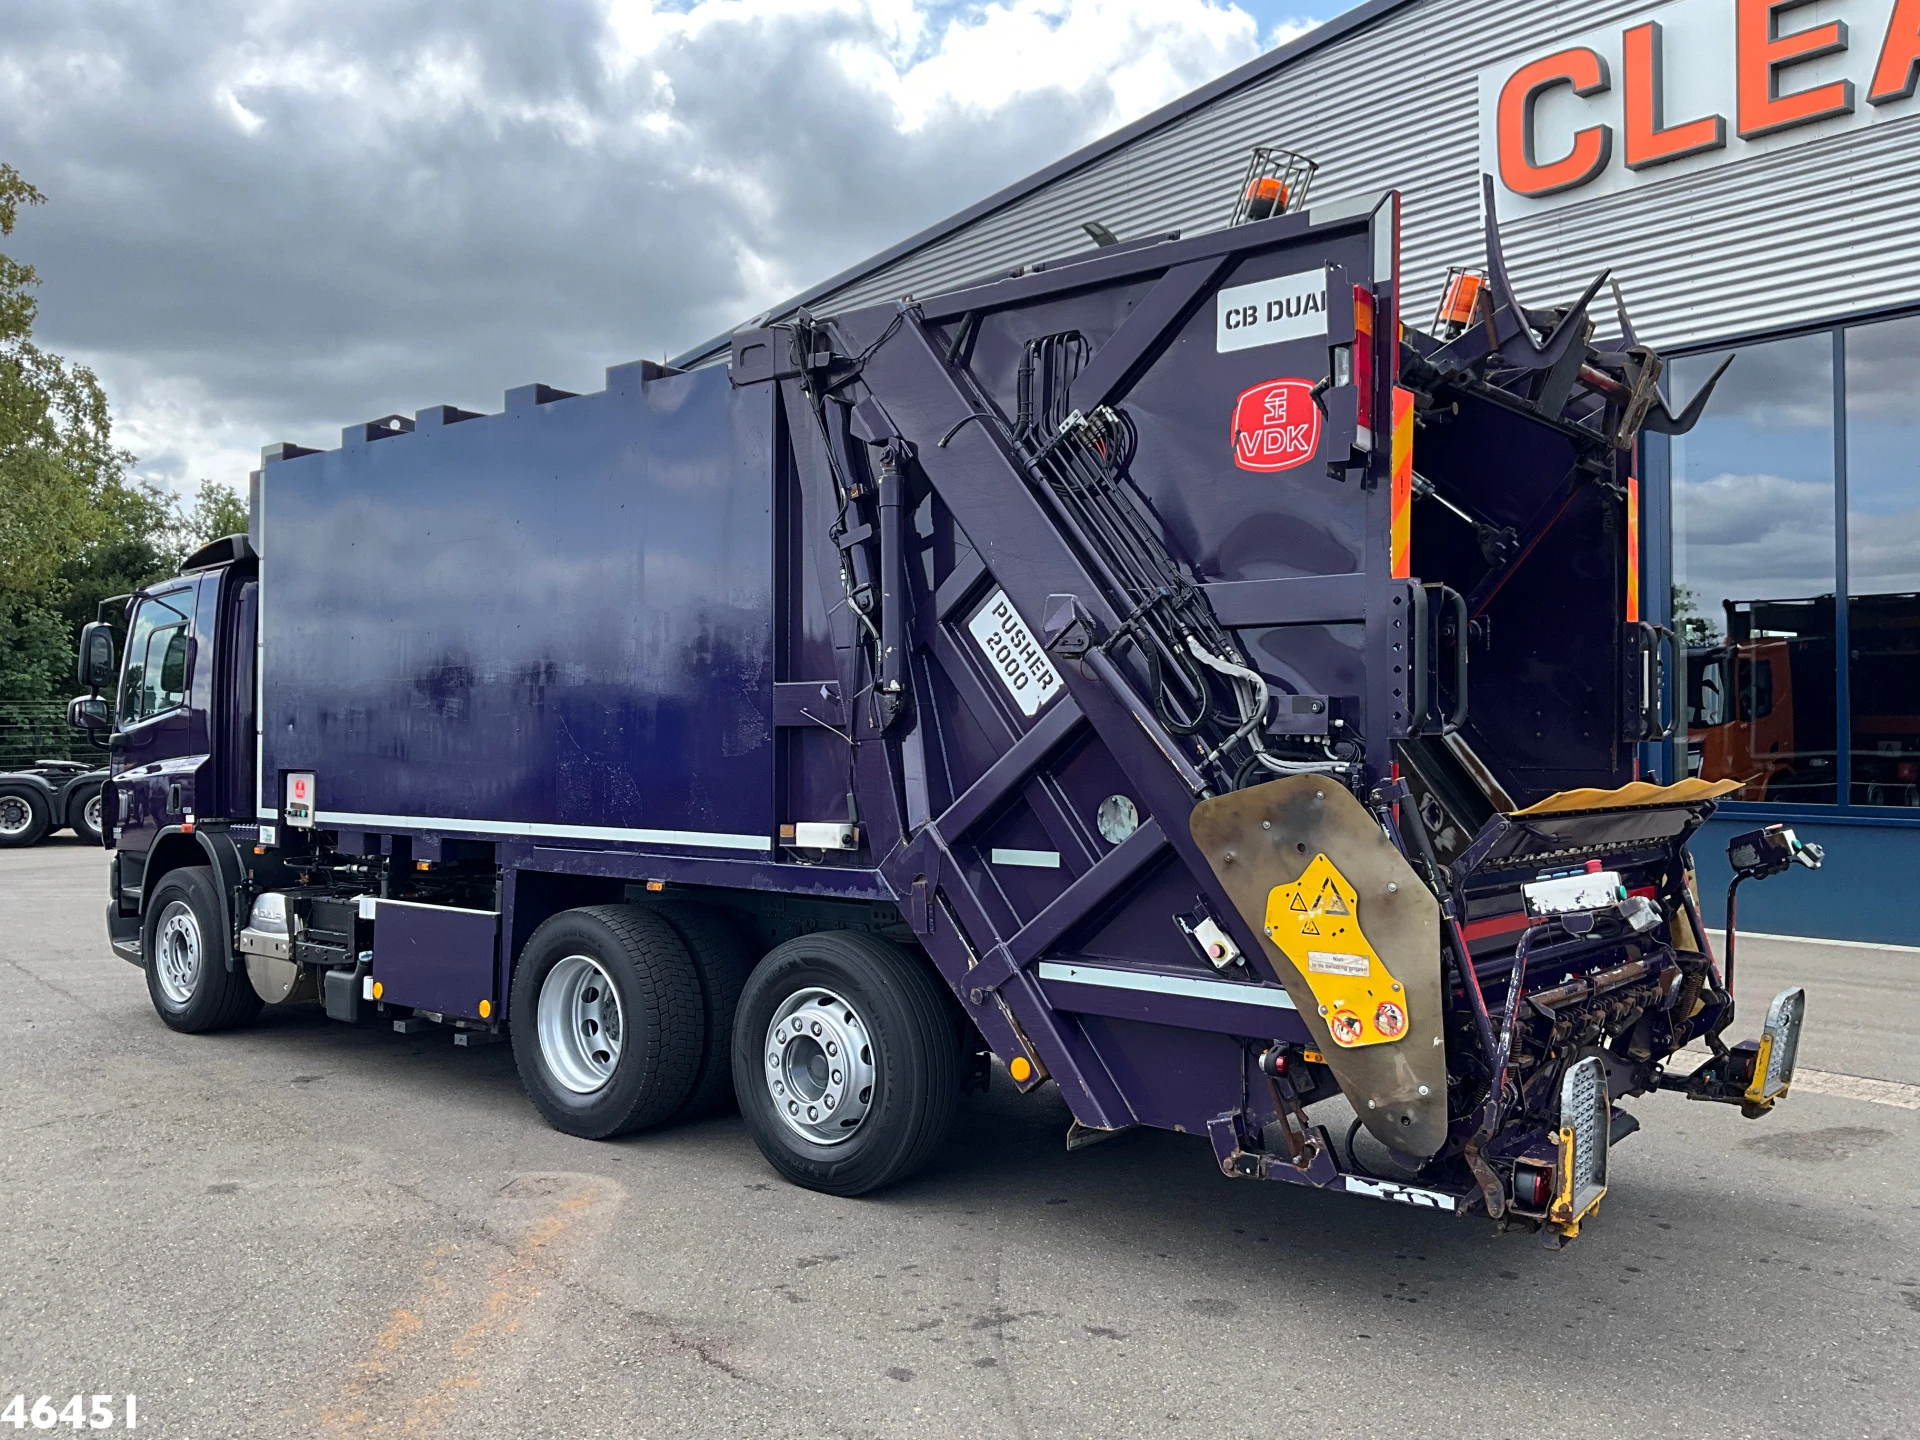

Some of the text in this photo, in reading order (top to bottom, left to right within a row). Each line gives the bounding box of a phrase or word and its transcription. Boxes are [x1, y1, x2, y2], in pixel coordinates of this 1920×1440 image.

[1225, 305, 1258, 330] CB
[1240, 423, 1310, 457] VDK
[986, 631, 1029, 691] 2000
[991, 600, 1055, 691] PUSHER
